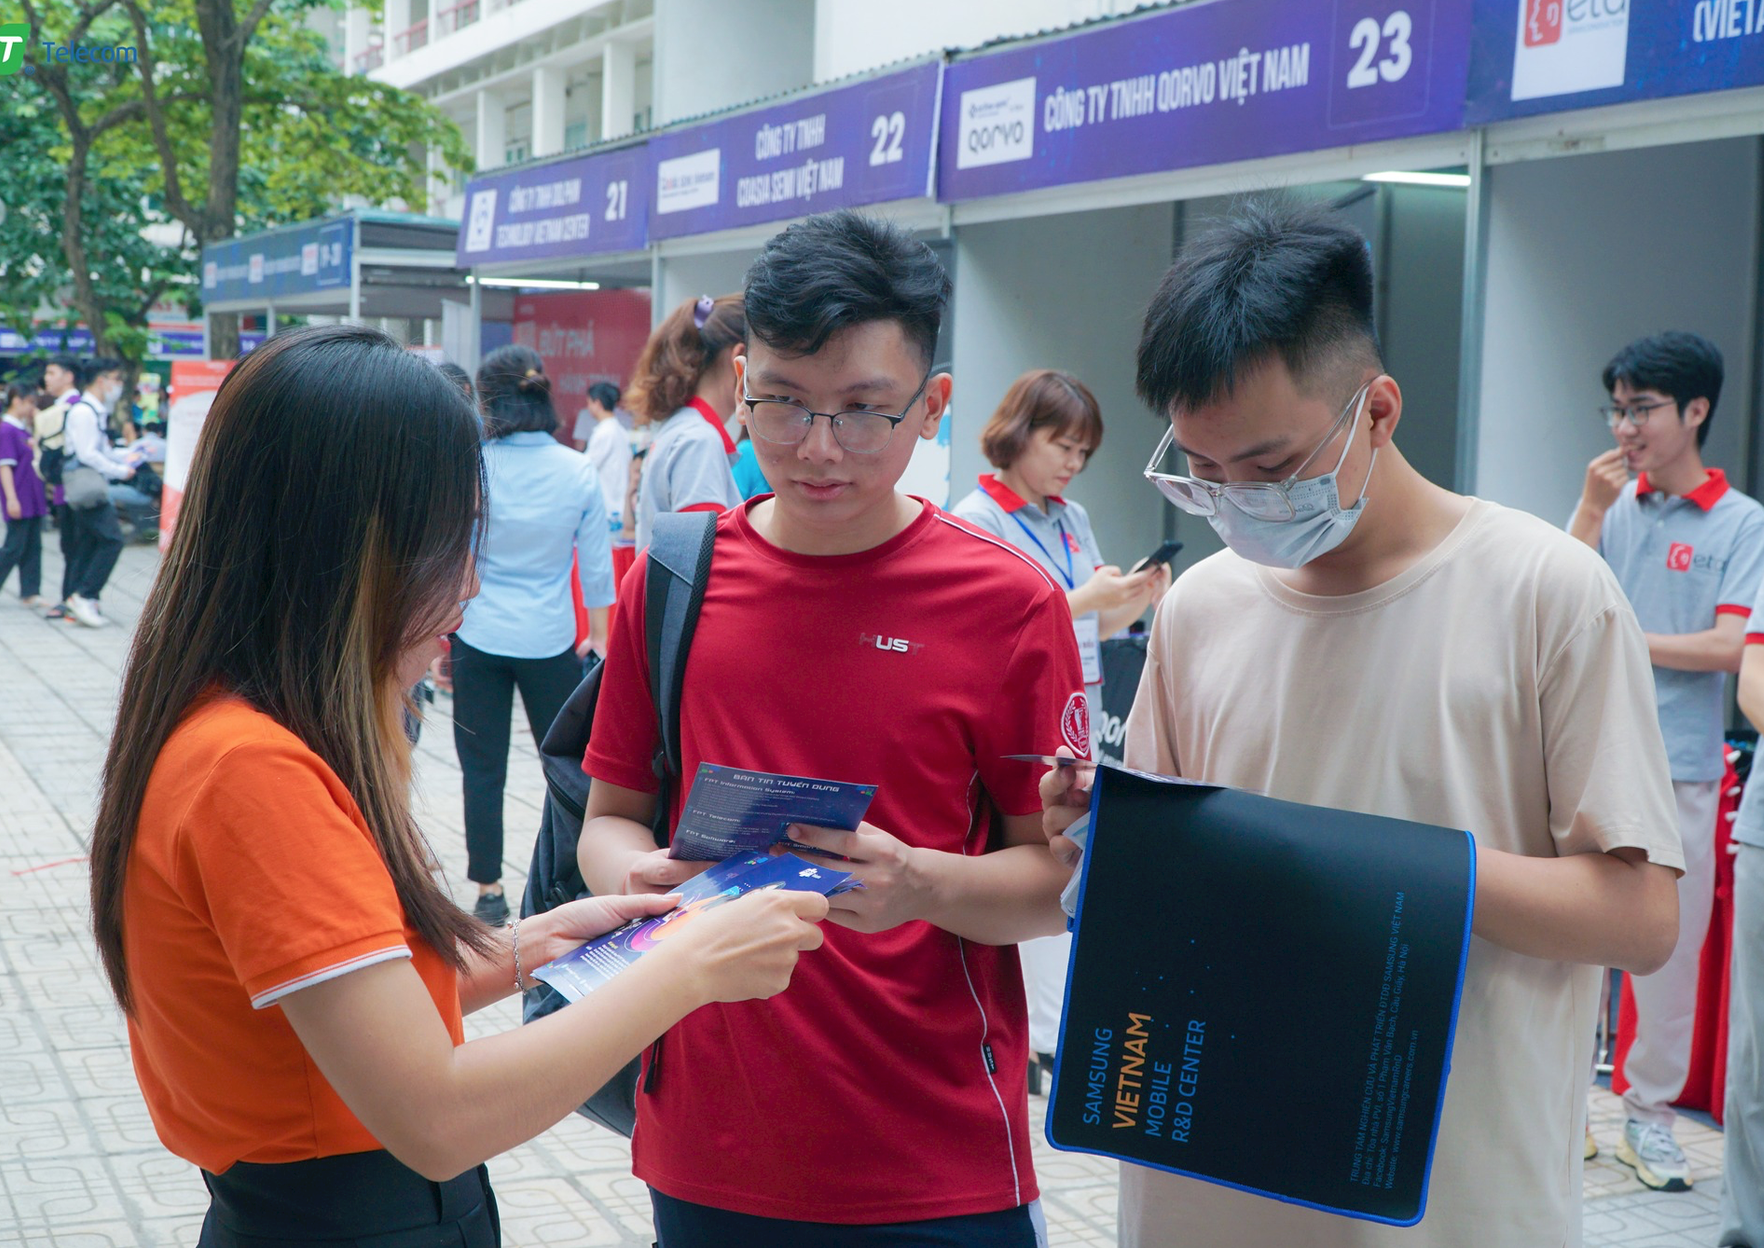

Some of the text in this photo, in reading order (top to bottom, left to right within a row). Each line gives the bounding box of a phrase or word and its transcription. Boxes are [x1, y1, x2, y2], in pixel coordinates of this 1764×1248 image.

[1346, 10, 1412, 89] 23
[1044, 86, 1085, 132] CÔNG
[1087, 84, 1109, 124] TY
[1111, 74, 1155, 121] TNHH
[1157, 62, 1216, 113] QORVO
[1218, 47, 1262, 106] VIỆT
[1262, 42, 1310, 92] NAM
[755, 113, 826, 161] CÔNG TY TNHH
[869, 111, 905, 166] 22
[605, 180, 628, 221] 21
[796, 157, 820, 201] VIỆT
[818, 156, 844, 192] NAM
[859, 632, 925, 656] HUST
[1391, 914, 1401, 935] VIỆT
[1395, 891, 1404, 913] NAM
[1384, 936, 1397, 982] SAMSUNG
[1082, 1027, 1113, 1126] SAMSUNG
[1112, 1012, 1152, 1129] VIETNAM
[1171, 1019, 1207, 1143] R&D CENTER
[1368, 1062, 1376, 1075] VÀ
[1144, 1060, 1172, 1137] MOBILE
[1351, 1152, 1361, 1182] TRUNG
